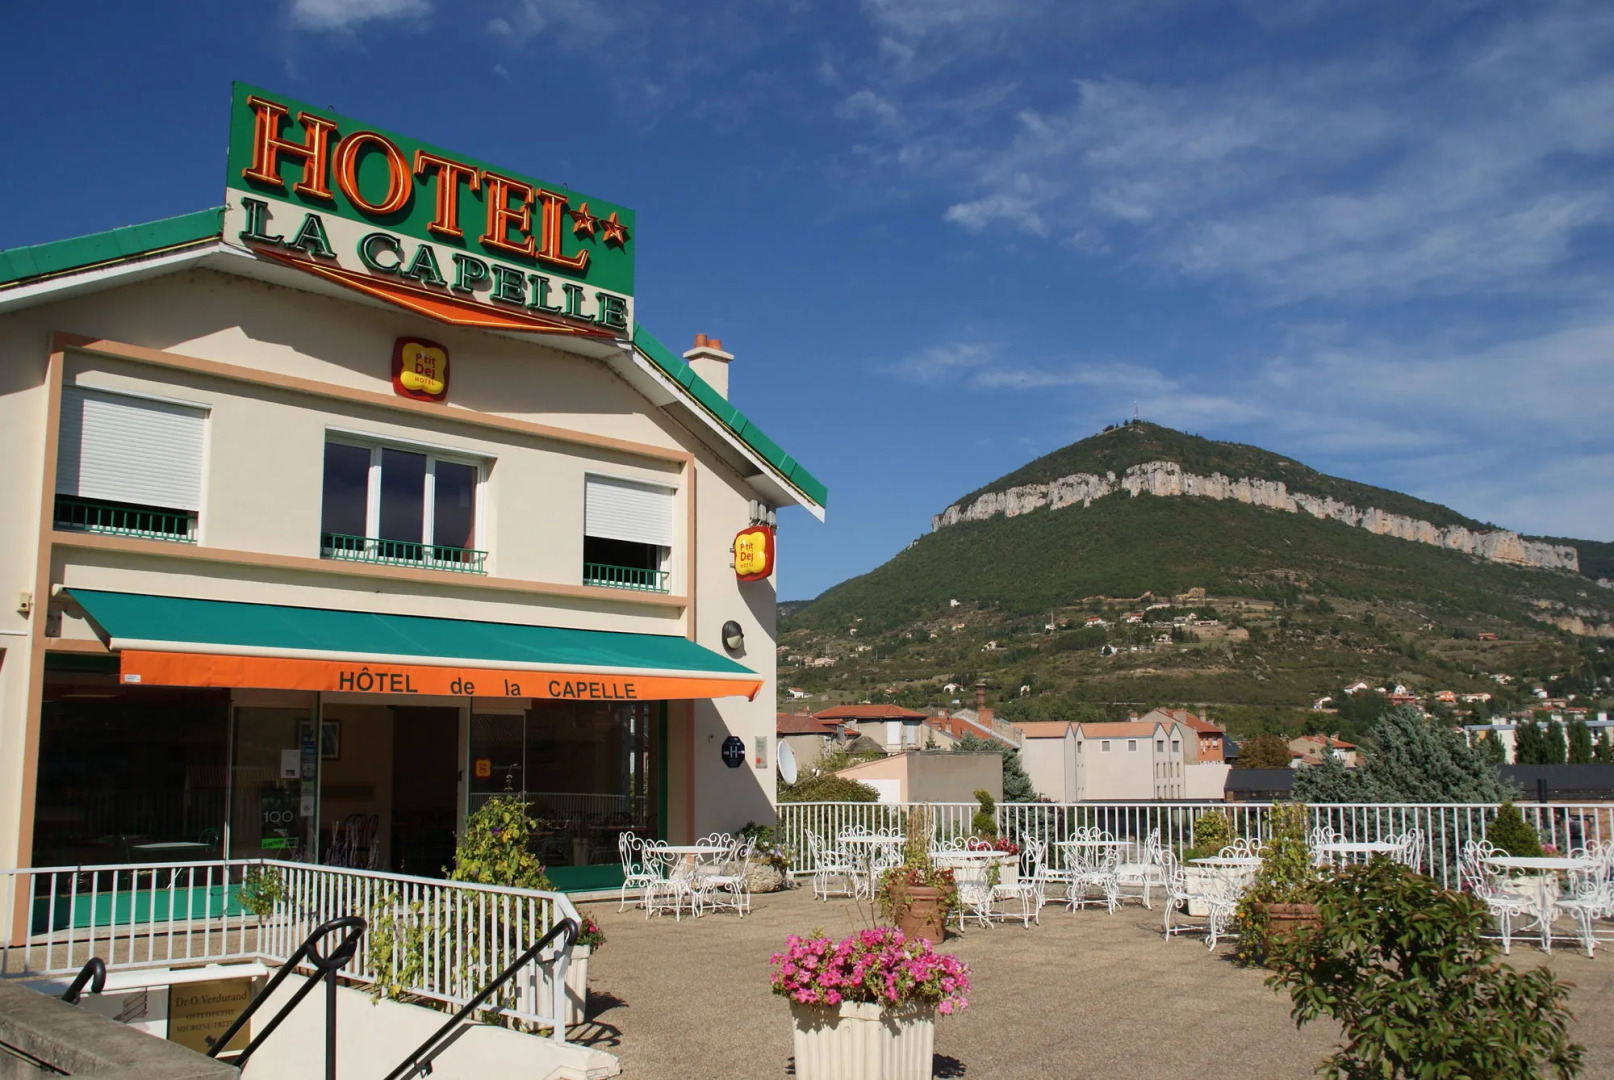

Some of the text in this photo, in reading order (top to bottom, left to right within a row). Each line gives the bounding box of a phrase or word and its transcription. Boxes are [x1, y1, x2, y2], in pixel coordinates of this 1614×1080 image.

[241, 94, 590, 270] HOTEL
[239, 196, 629, 331] LA CAPELLE
[414, 376, 435, 385] HOTEL
[338, 667, 638, 699] HÔTEL de la CAPELLE
[263, 810, 293, 823] 100
[175, 997, 187, 1007] Dr
